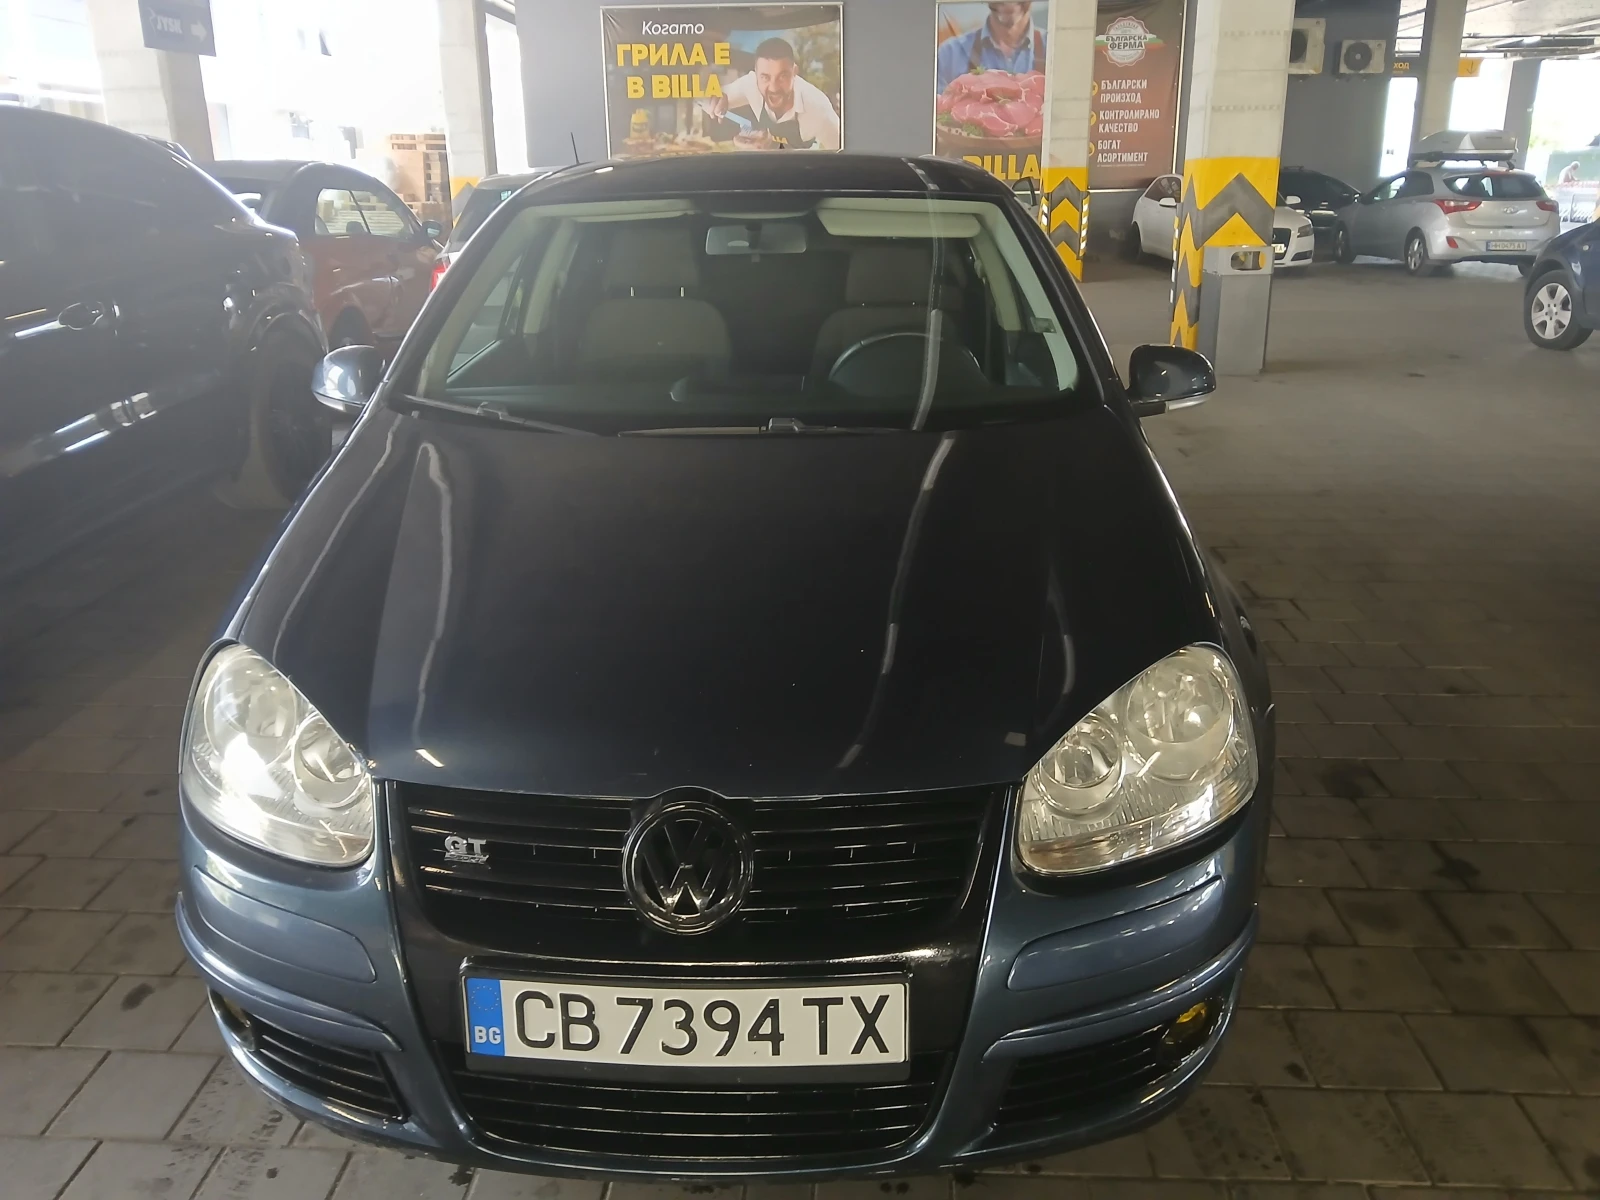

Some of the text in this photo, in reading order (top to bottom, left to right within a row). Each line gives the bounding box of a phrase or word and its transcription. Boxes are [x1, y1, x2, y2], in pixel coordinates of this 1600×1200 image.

[642, 21, 705, 36] Когато
[1109, 41, 1144, 50] ФЕРМА
[616, 43, 730, 67] ГРИЛА Е
[627, 74, 723, 99] В BILLA
[1101, 79, 1147, 90] БЪЛГАРСКИ
[1100, 93, 1142, 104] ПРОИЗХОД
[1099, 109, 1160, 120] КОНТРОЛИРАНО
[1098, 123, 1139, 133] КАЧЕСТВО
[1097, 140, 1121, 150] БОГАТ
[1096, 152, 1149, 163] АСОРТИМЕНТ
[444, 835, 487, 855] GT
[515, 990, 891, 1057] CB 7394 TX
[474, 1026, 501, 1044] BG
